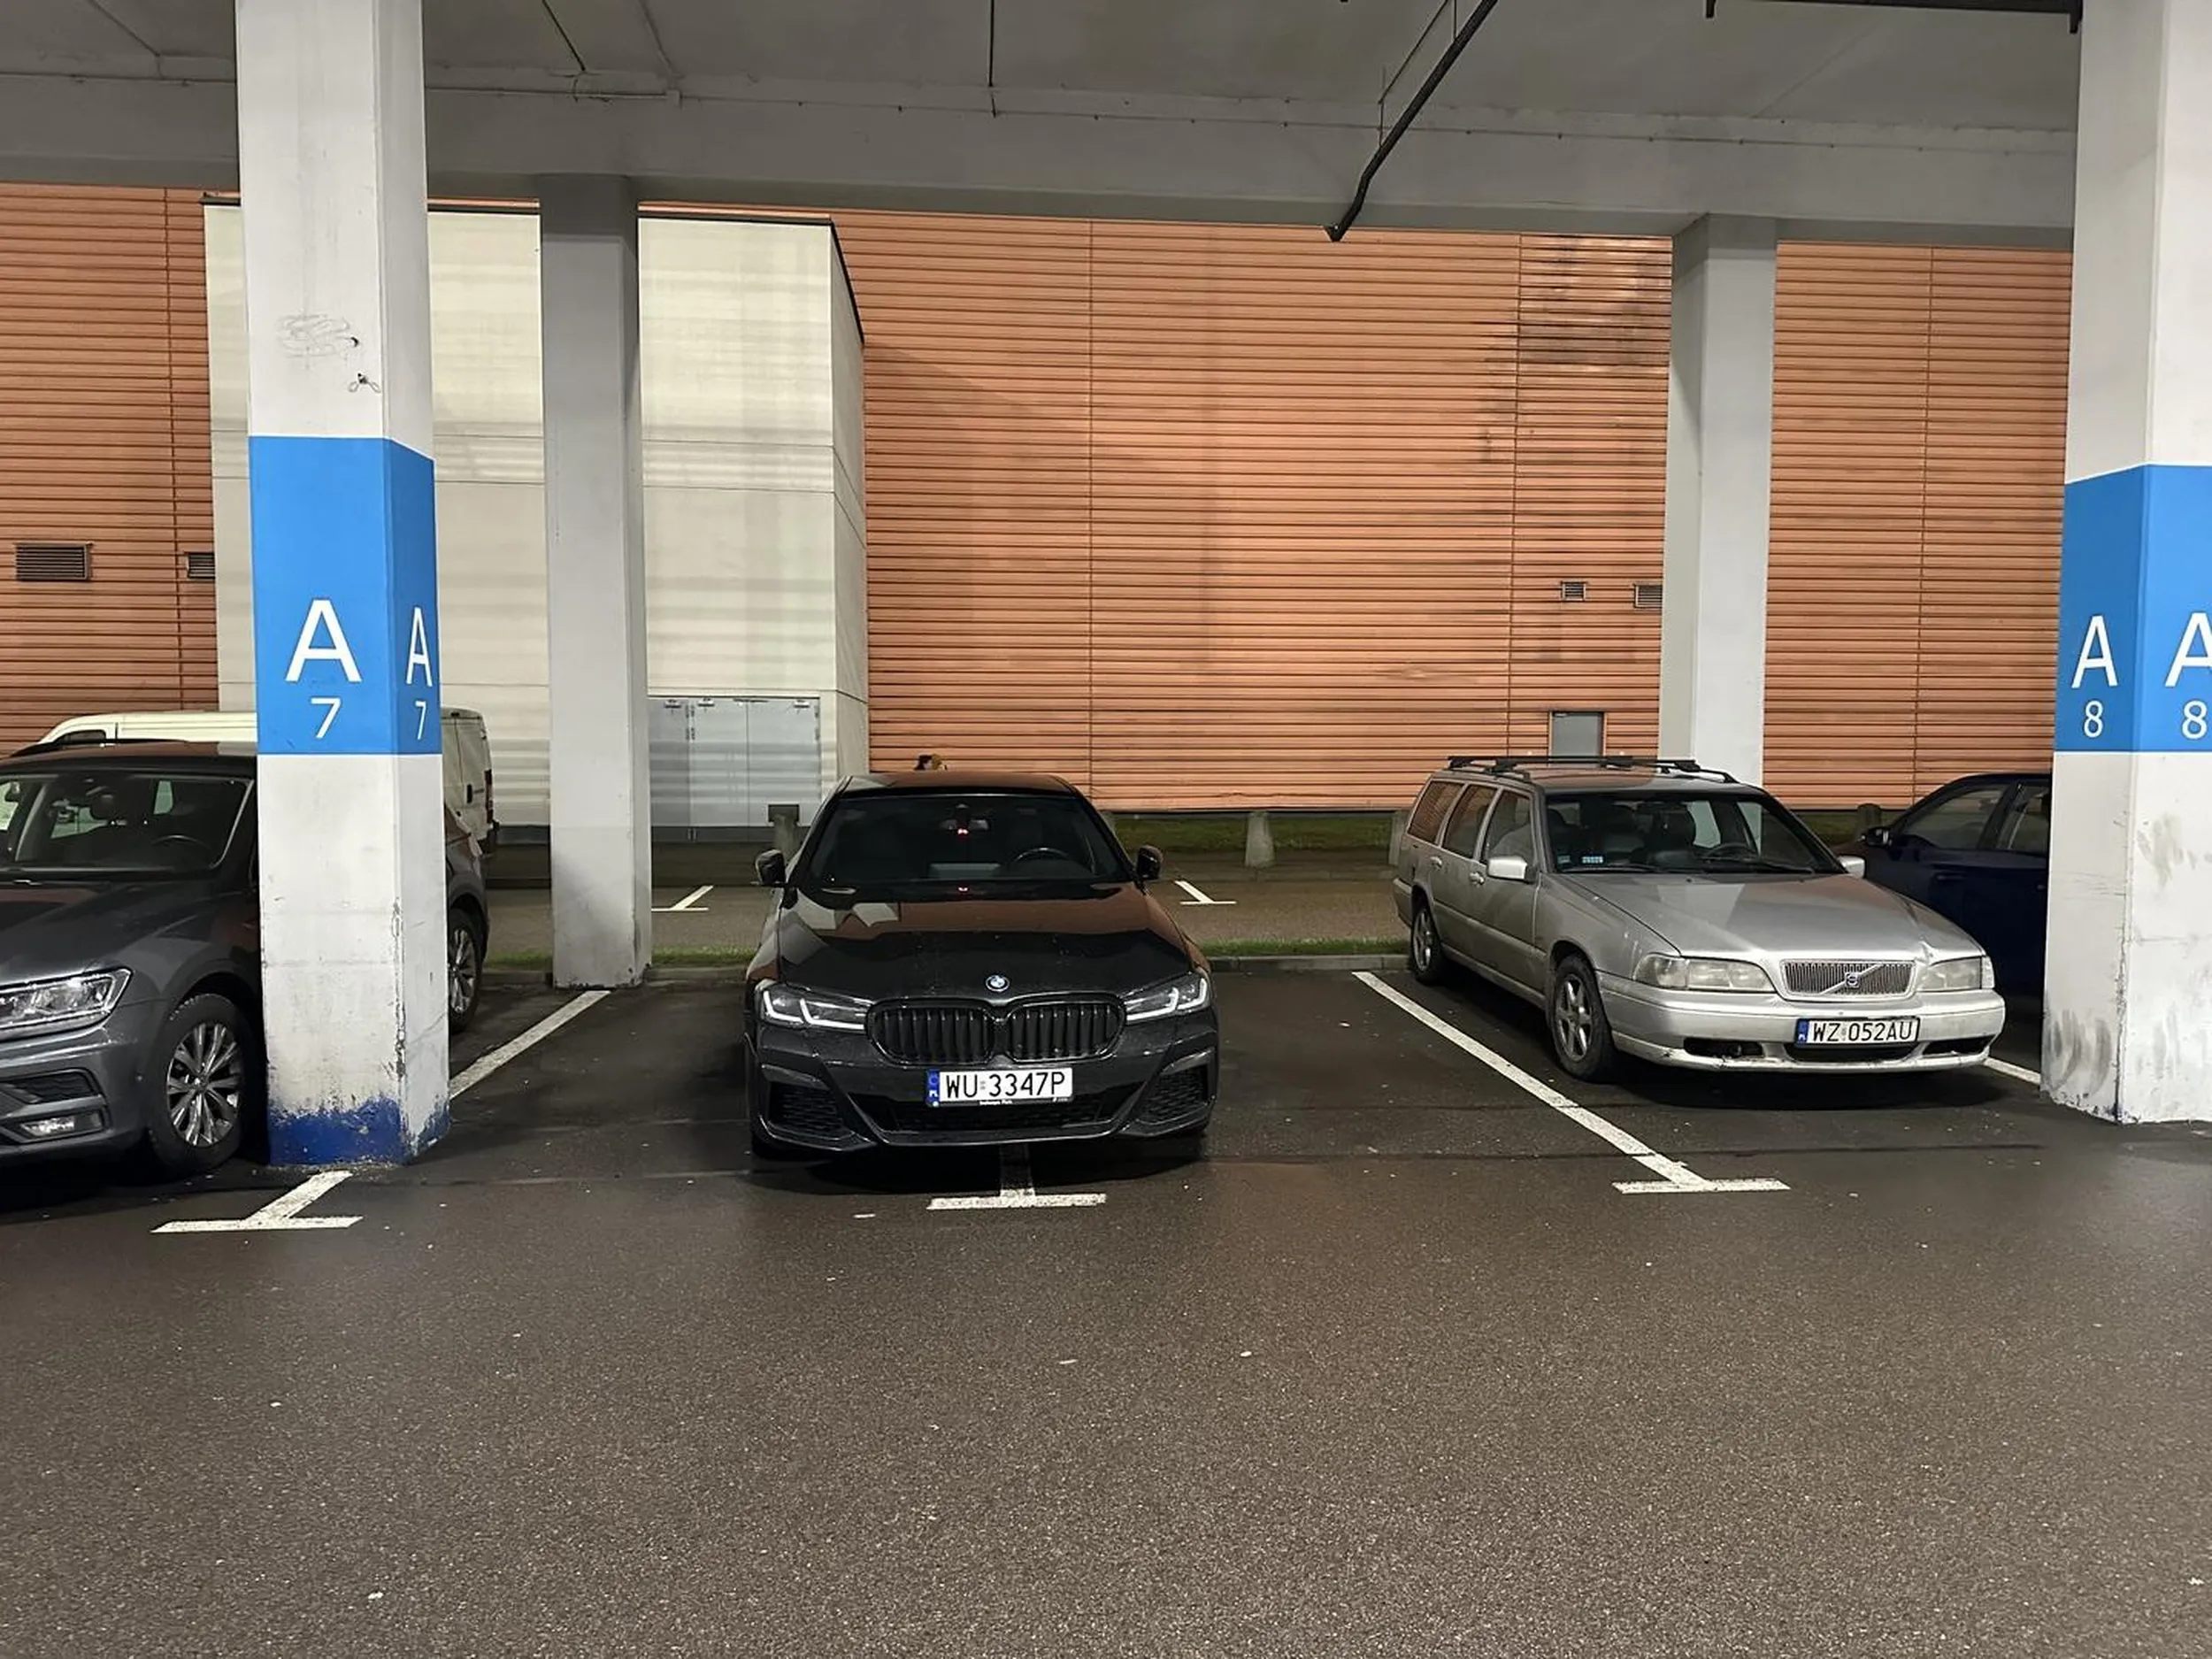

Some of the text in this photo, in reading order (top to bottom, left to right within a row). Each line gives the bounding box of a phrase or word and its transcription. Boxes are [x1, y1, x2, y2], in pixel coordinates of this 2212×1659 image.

[285, 599, 362, 681] A
[406, 607, 433, 687] A
[2071, 615, 2118, 688] A
[2165, 612, 2212, 687] A
[311, 697, 342, 739] 7
[415, 701, 427, 740] 7
[2084, 700, 2103, 738] 8
[2182, 700, 2208, 739] 8
[1813, 1021, 1913, 1042] WZ 052AU
[946, 1071, 1065, 1098] WU 3347P
